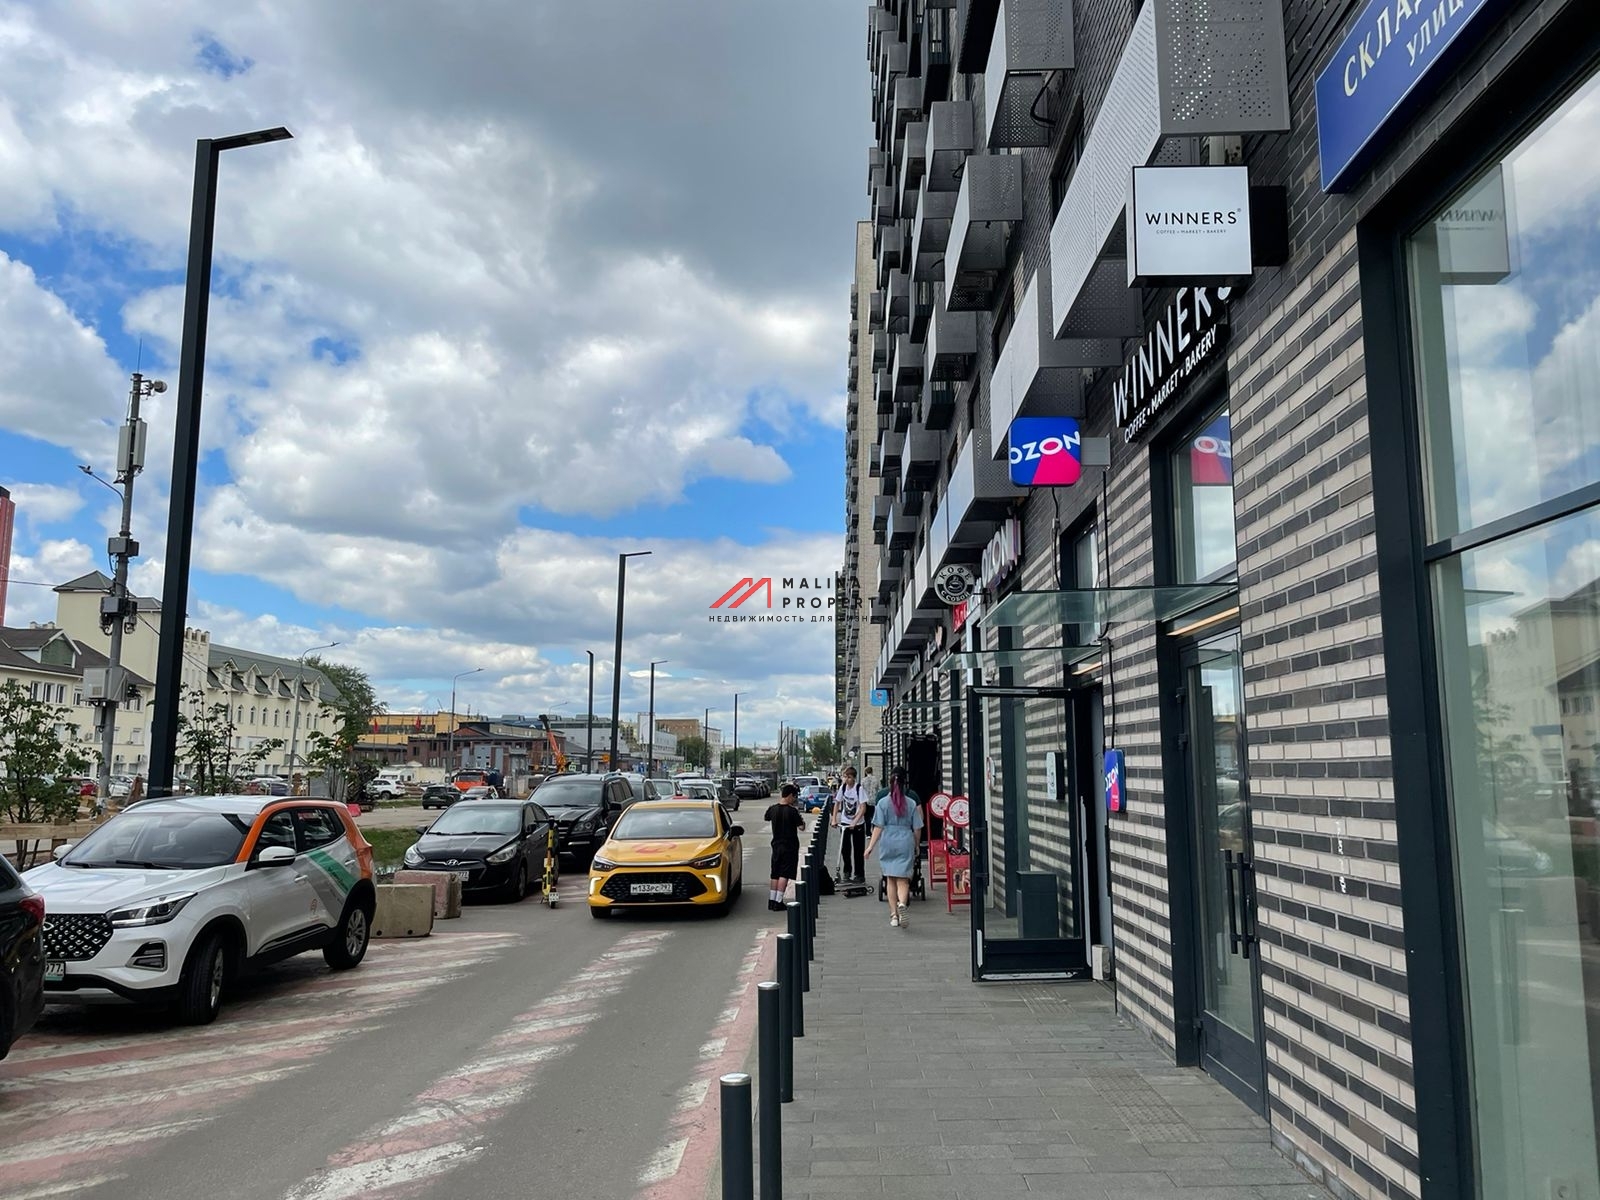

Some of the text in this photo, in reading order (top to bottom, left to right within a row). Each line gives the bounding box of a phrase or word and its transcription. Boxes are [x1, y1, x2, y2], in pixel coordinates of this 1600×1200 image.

[1145, 211, 1238, 225] WINNERS
[1124, 323, 1217, 443] COFFEE MARKET BAKERY
[1010, 430, 1081, 465] OZON
[939, 566, 971, 580] КОФЕ
